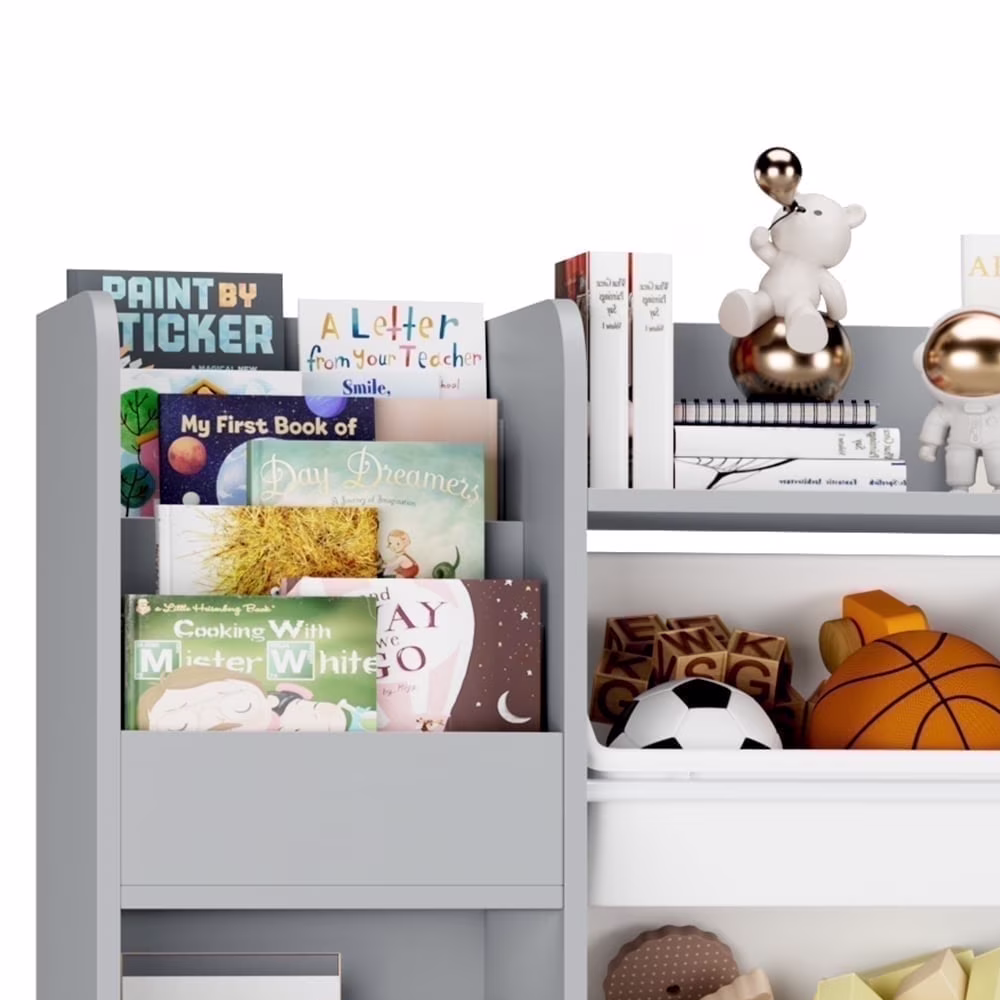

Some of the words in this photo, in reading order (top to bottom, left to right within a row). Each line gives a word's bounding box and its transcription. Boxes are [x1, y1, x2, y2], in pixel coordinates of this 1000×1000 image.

[102, 275, 214, 310] PAINT
[218, 282, 257, 308] BY
[118, 312, 274, 354] TICKER
[321, 312, 340, 340] A
[351, 305, 459, 341] Letter
[307, 344, 350, 372] from
[352, 349, 396, 370] your
[399, 342, 482, 368] Teacher
[342, 378, 392, 396] Smile,
[181, 414, 210, 438] My
[216, 414, 269, 434] First
[274, 416, 328, 435] Book
[334, 418, 358, 436] of
[260, 453, 329, 500] Day
[342, 446, 480, 503] Dreamers
[364, 586, 390, 602] nd
[173, 619, 266, 642] Cooking
[268, 619, 332, 639] With
[376, 601, 448, 632] AY
[725, 659, 771, 702] G
